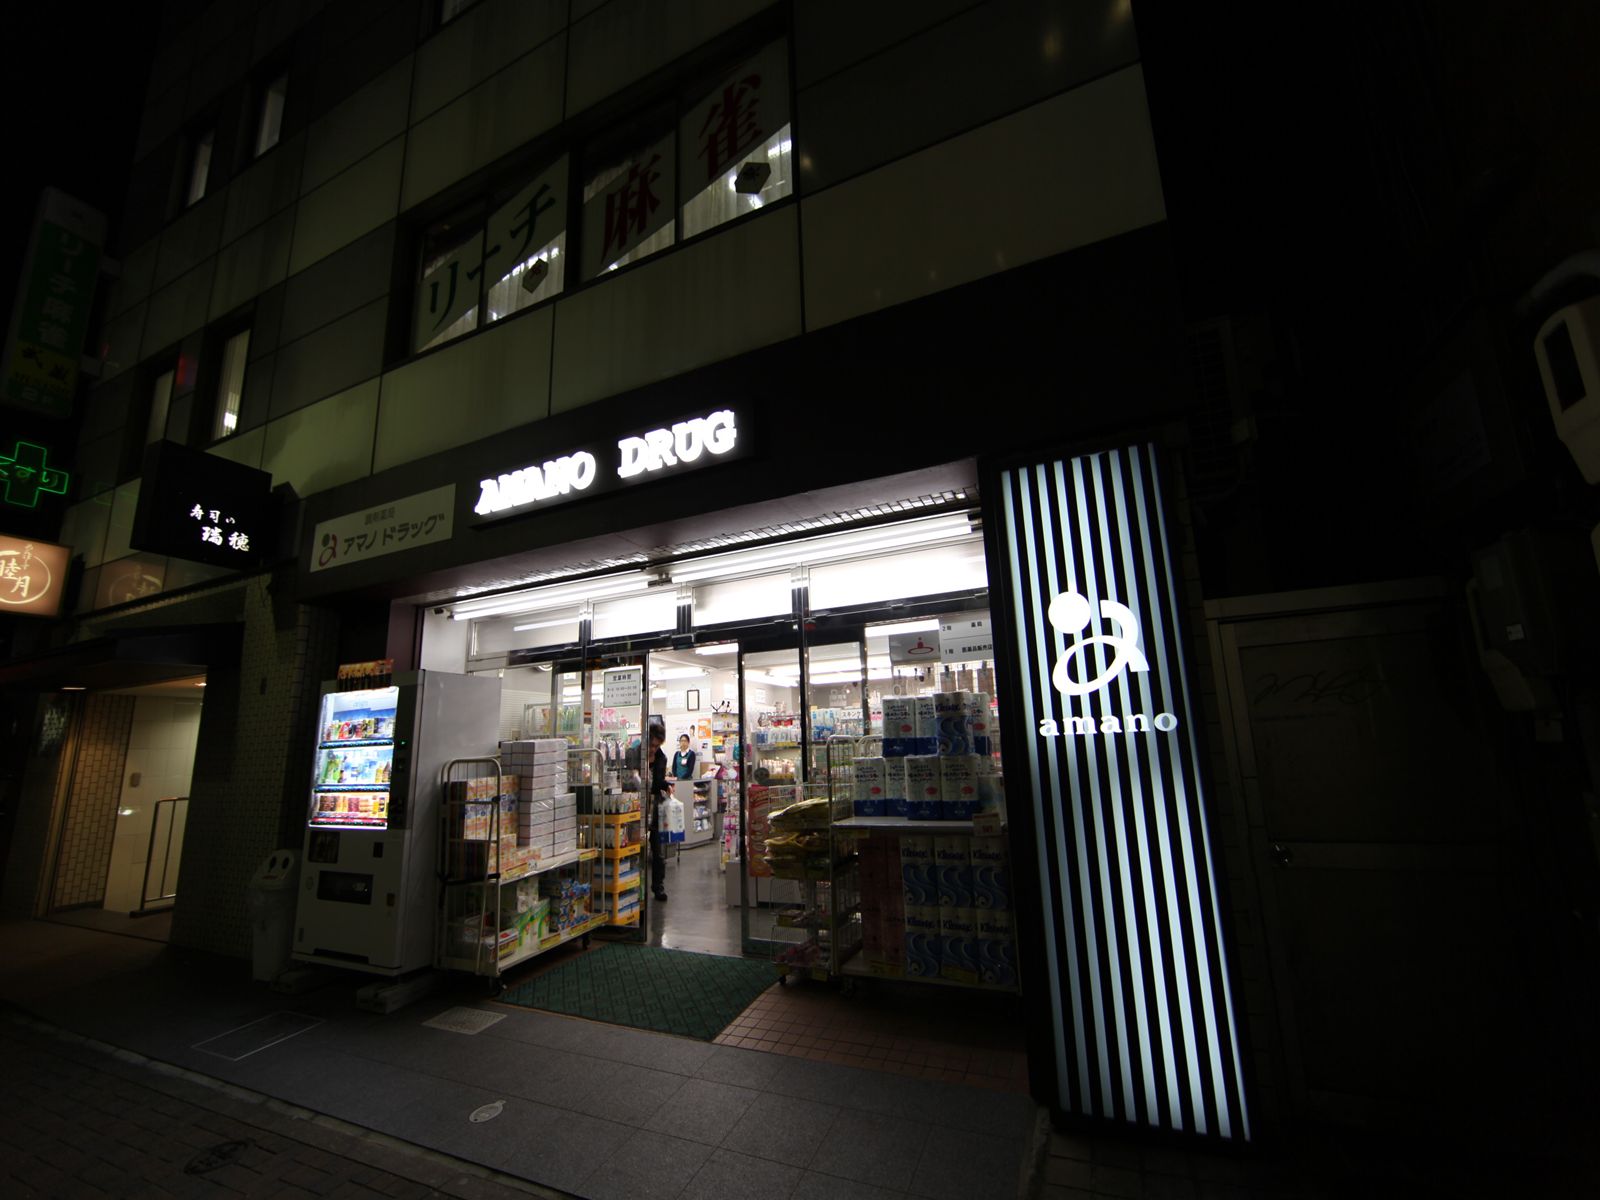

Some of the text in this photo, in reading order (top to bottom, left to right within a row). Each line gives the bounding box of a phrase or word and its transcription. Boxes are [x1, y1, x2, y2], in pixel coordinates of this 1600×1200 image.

[474, 410, 737, 515] AMANO DRUG
[201, 526, 250, 552] 瑞穂
[1039, 712, 1178, 737] amano
